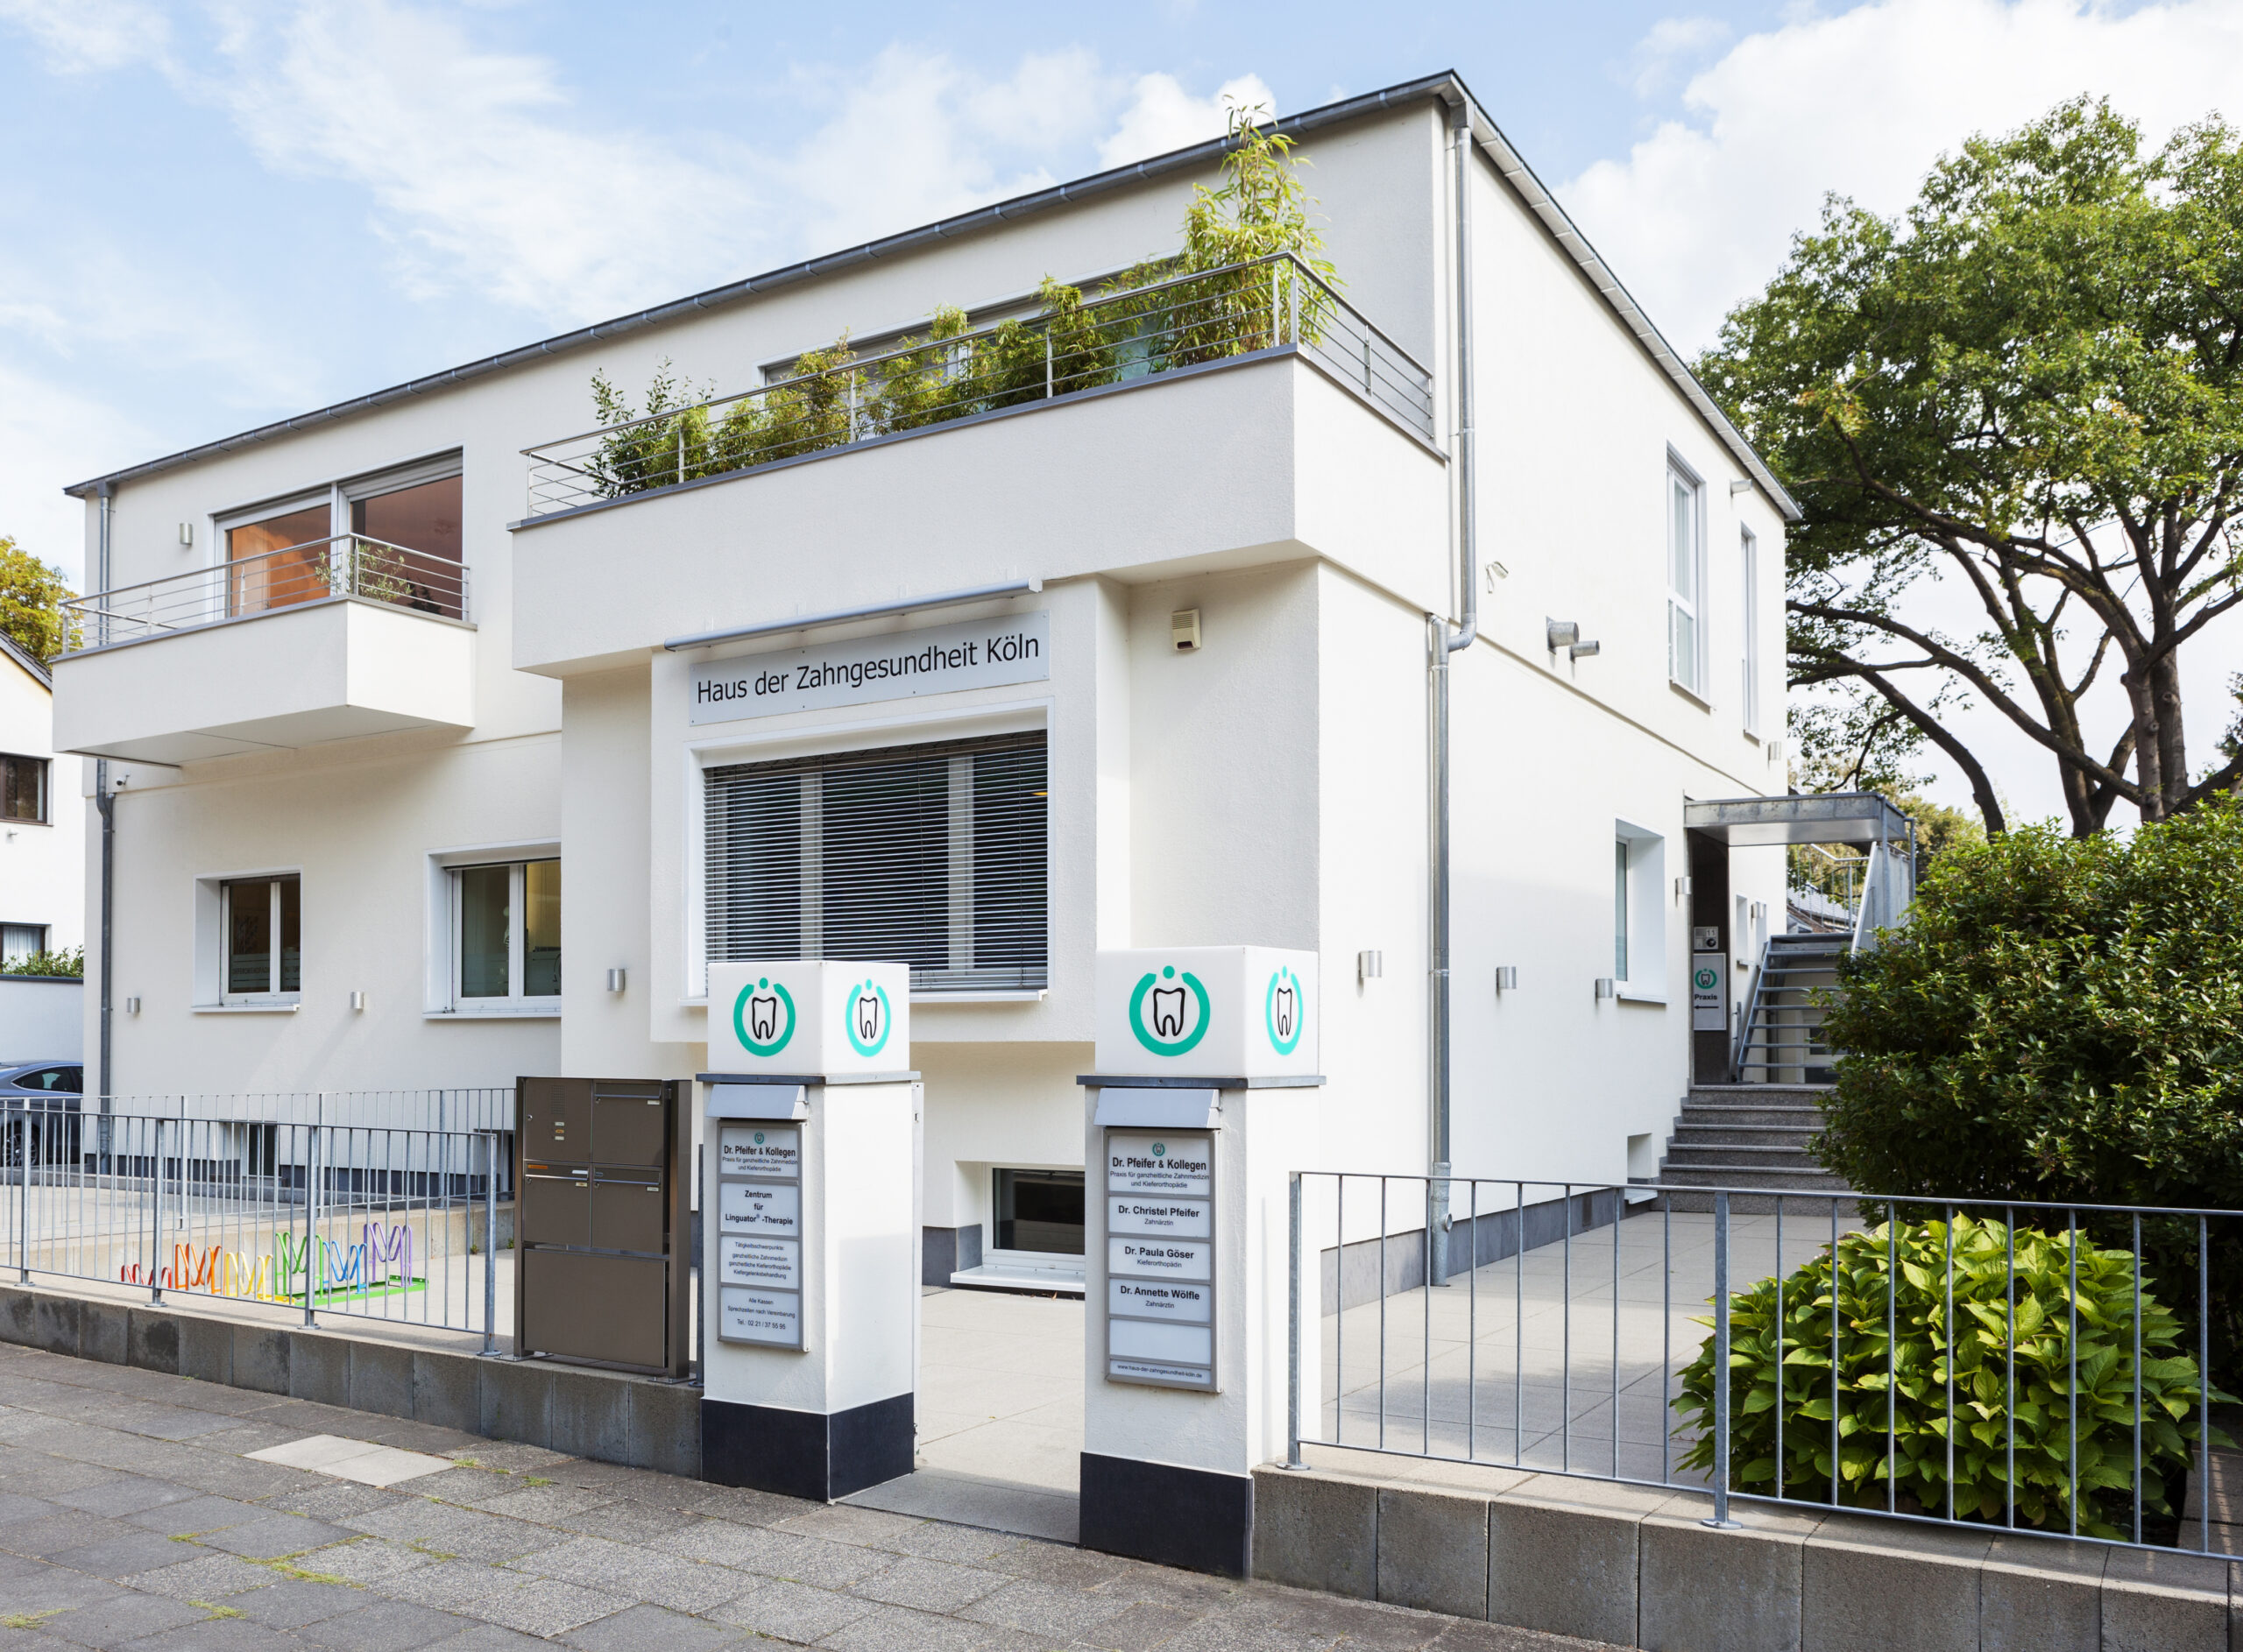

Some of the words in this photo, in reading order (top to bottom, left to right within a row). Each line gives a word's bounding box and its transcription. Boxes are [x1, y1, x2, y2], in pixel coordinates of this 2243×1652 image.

[697, 680, 747, 703] Haus
[754, 671, 789, 695] der
[796, 641, 978, 689] Zahngesundheit
[987, 633, 1039, 663] Köln
[724, 1146, 733, 1154] Dr.
[735, 1146, 757, 1155] Pfeifer
[766, 1147, 796, 1158] Kollegen
[1113, 1157, 1125, 1168] Dr.
[1127, 1157, 1156, 1168] Pfeifer
[1158, 1160, 1164, 1168] &
[1167, 1159, 1206, 1172] Kollegen
[1136, 1172, 1172, 1181] ganzheitliche
[1118, 1204, 1130, 1214] Dr.
[1133, 1206, 1167, 1216] Christel
[1170, 1208, 1200, 1218] Pfeifer
[761, 1216, 793, 1225] -Therapie
[1124, 1246, 1137, 1255] Dr.
[1139, 1247, 1164, 1257] Paula
[1166, 1248, 1194, 1259] Göser
[1136, 1259, 1182, 1268] Kieferorthopädin
[1121, 1285, 1133, 1295] Dr.
[1134, 1287, 1169, 1297] Annette
[1171, 1289, 1200, 1301] Wölfle
[1145, 1300, 1175, 1309] Zahnärztin
